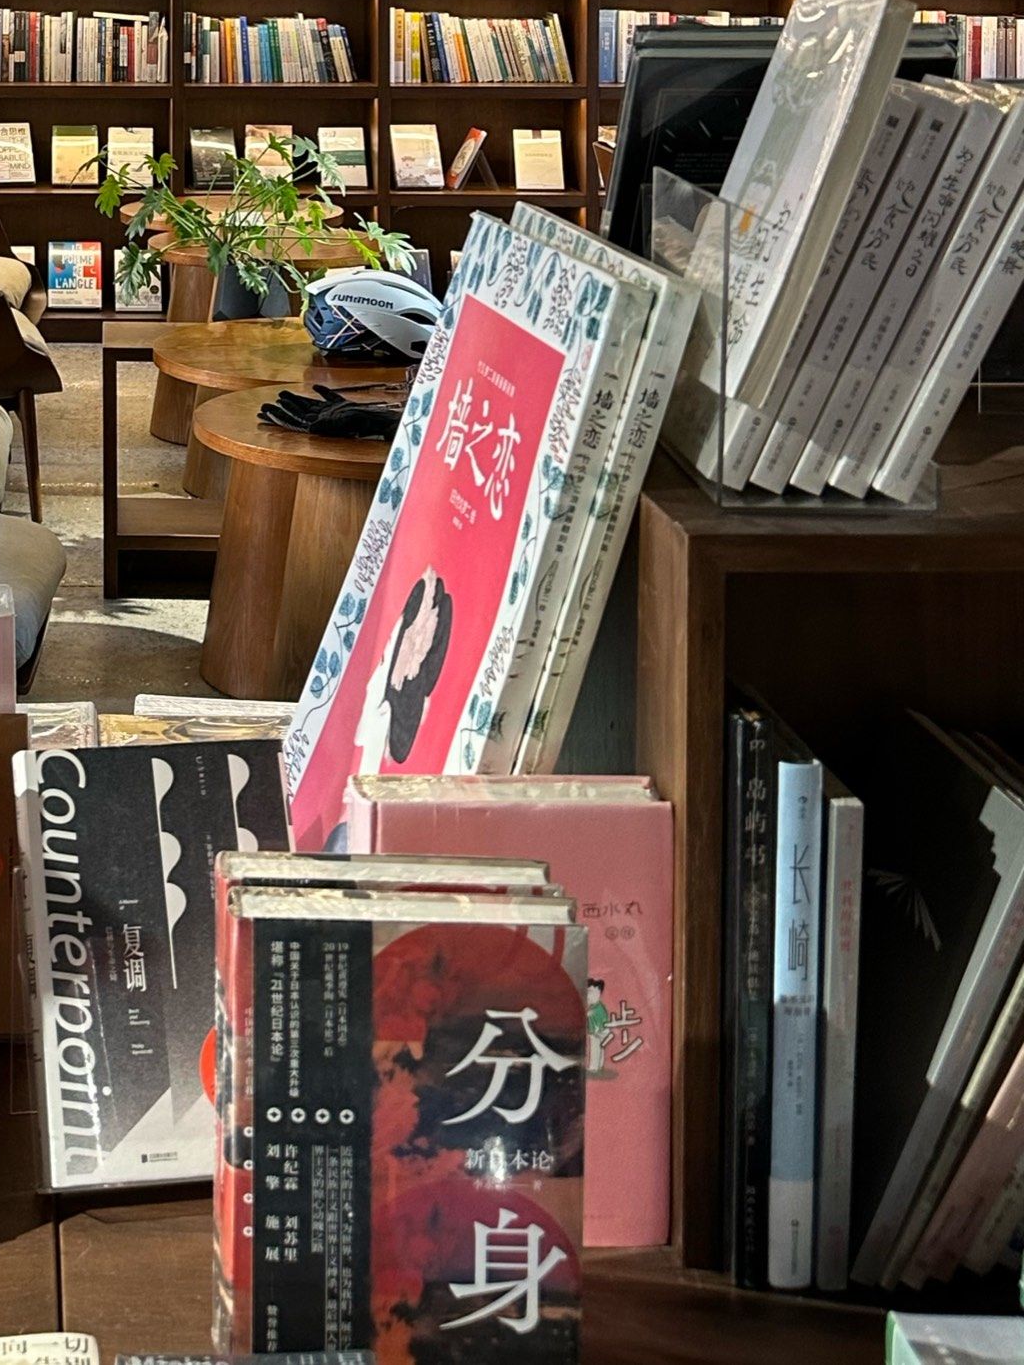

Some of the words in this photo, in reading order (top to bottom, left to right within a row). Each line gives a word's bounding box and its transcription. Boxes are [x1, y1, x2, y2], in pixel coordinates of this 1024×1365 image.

[9, 163, 31, 171] MIND
[54, 277, 95, 290] L'ANGLE
[787, 843, 812, 982] 长崎
[123, 923, 148, 993] 复调
[441, 1007, 578, 1126] 分
[284, 1144, 299, 1191] 许纪霖
[284, 1216, 299, 1262] 刘苏里
[439, 1207, 568, 1334] 身
